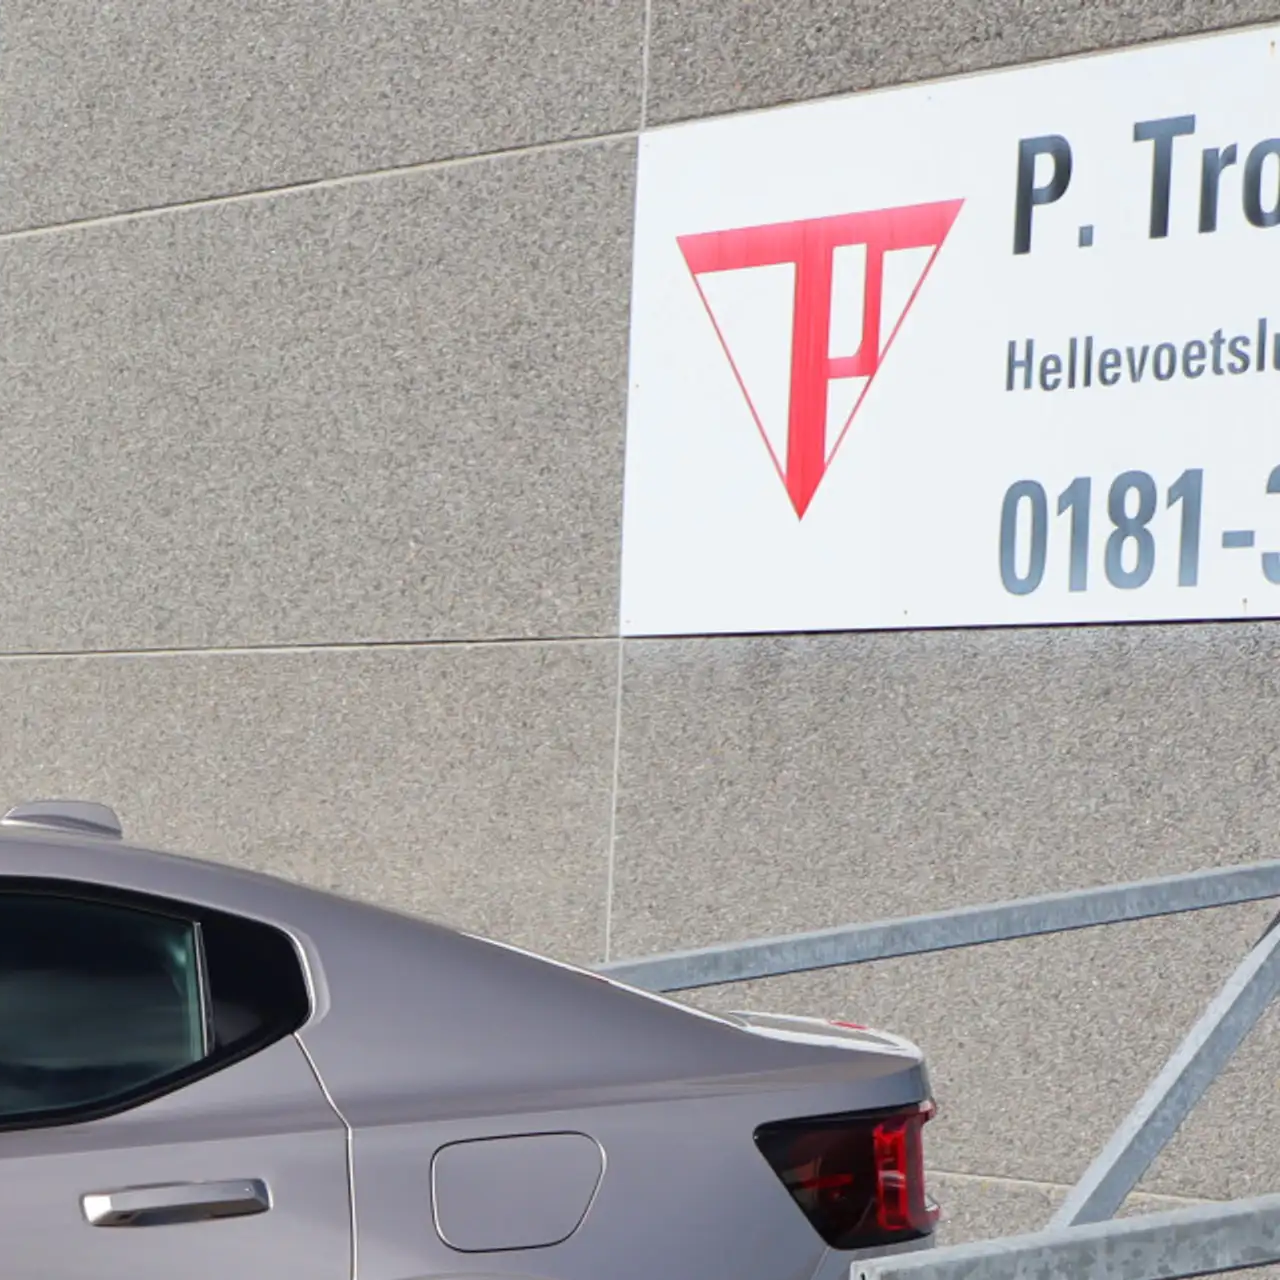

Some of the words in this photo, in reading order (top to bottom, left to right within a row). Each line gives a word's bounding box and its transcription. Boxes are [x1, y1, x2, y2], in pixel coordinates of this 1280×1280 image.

[1013, 133, 1094, 255] P.
[1133, 114, 1280, 239] Tro
[1005, 317, 1280, 392] Hellevoetsl
